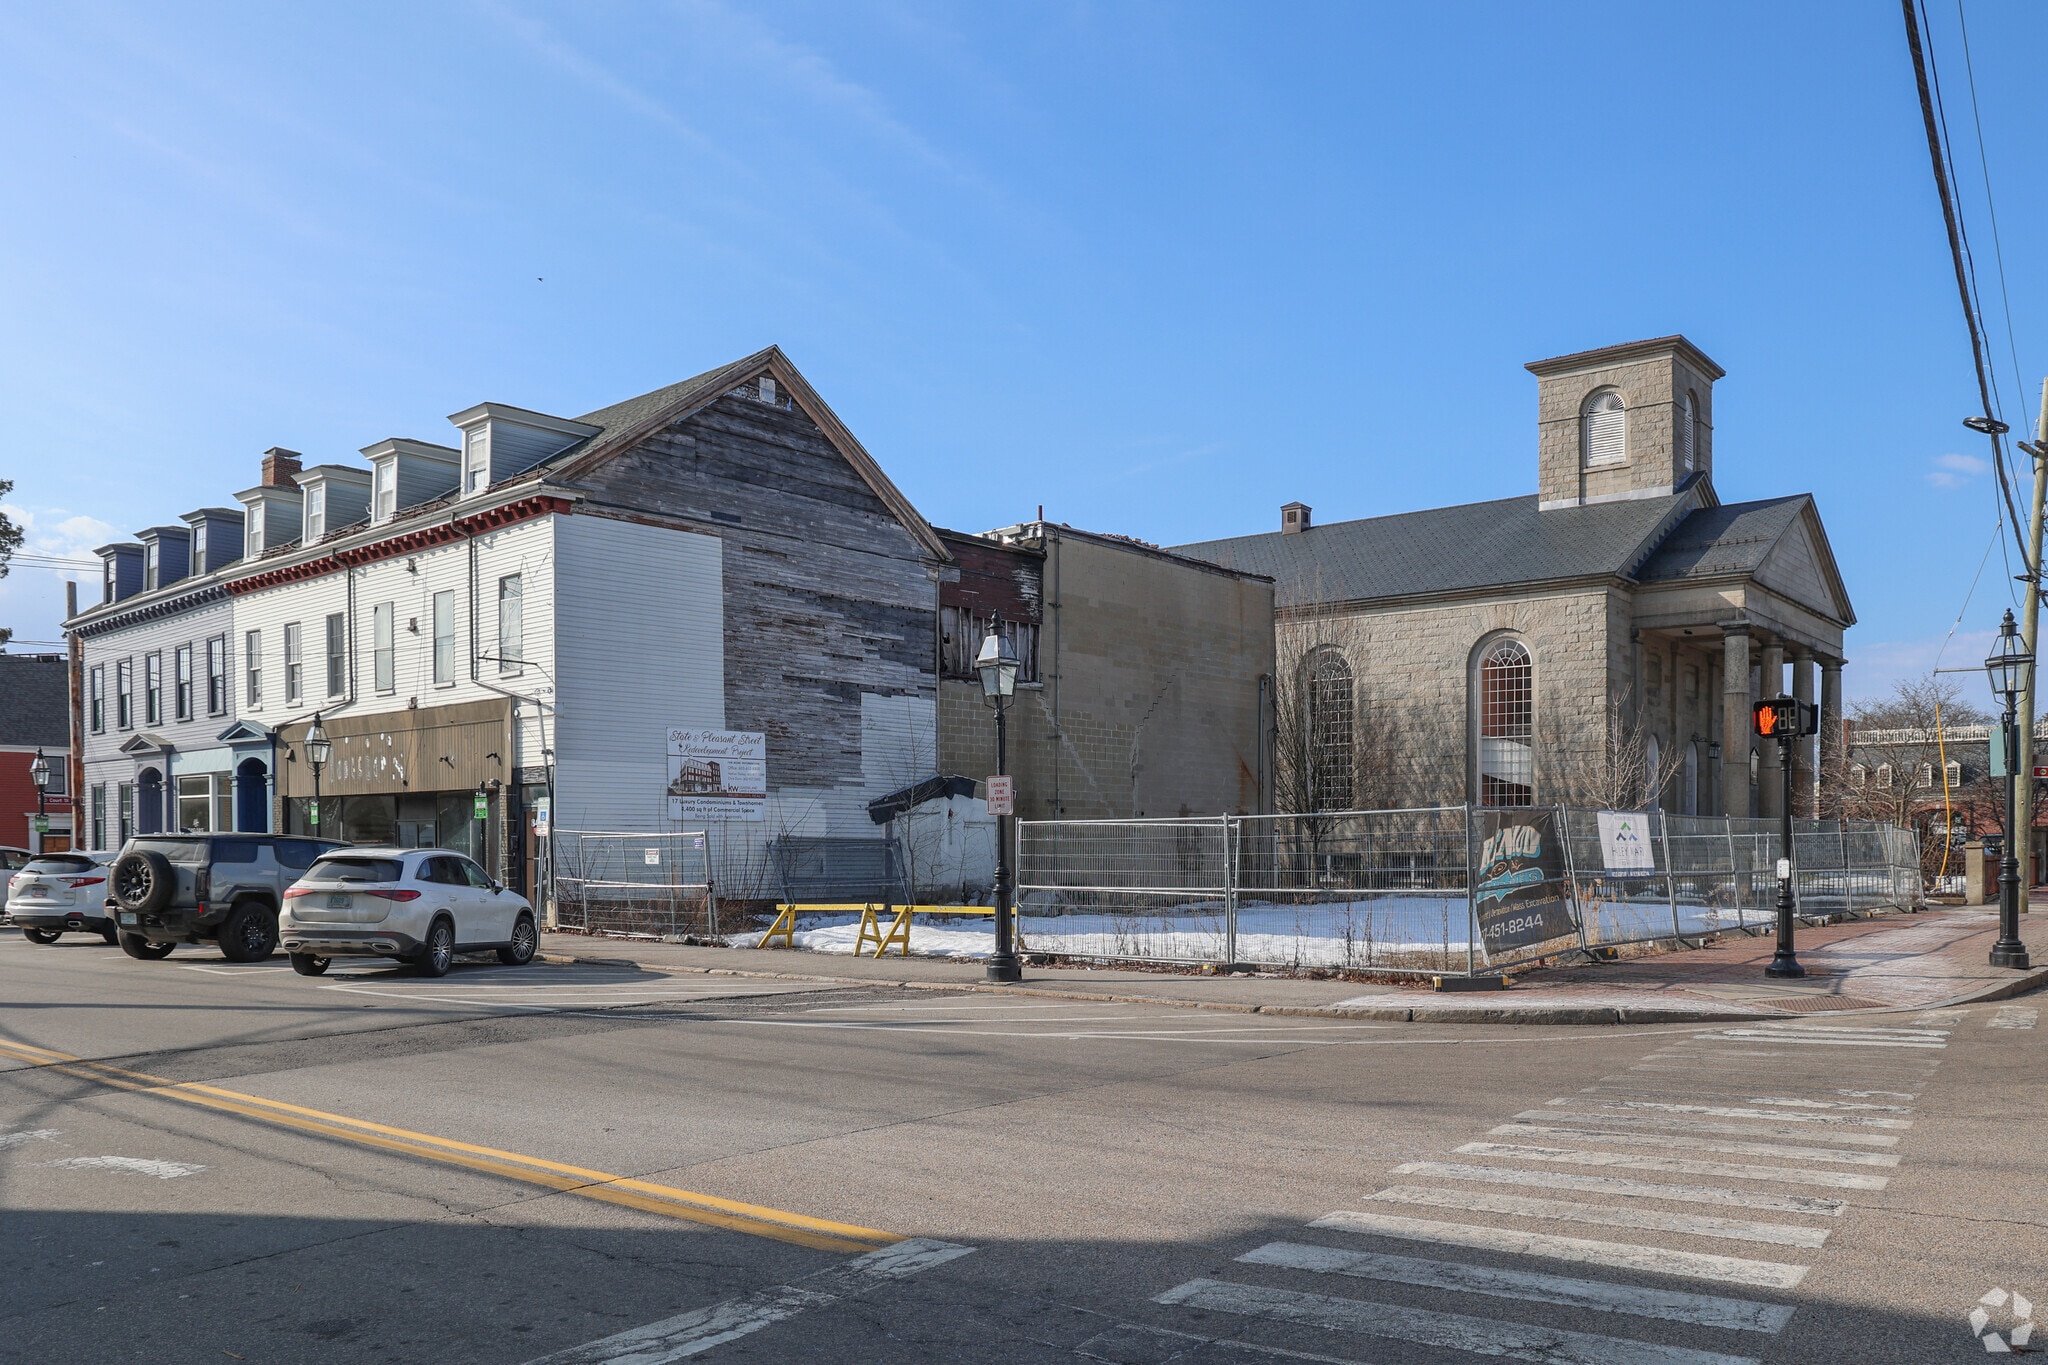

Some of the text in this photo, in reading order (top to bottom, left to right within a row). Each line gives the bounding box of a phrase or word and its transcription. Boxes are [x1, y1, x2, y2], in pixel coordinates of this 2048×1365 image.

[669, 730, 691, 741] State
[701, 731, 736, 743] Pleasant
[738, 734, 762, 745] Street
[682, 744, 754, 759] Redevelopment Project
[728, 783, 739, 792] kw
[1526, 894, 1560, 908] Excavation
